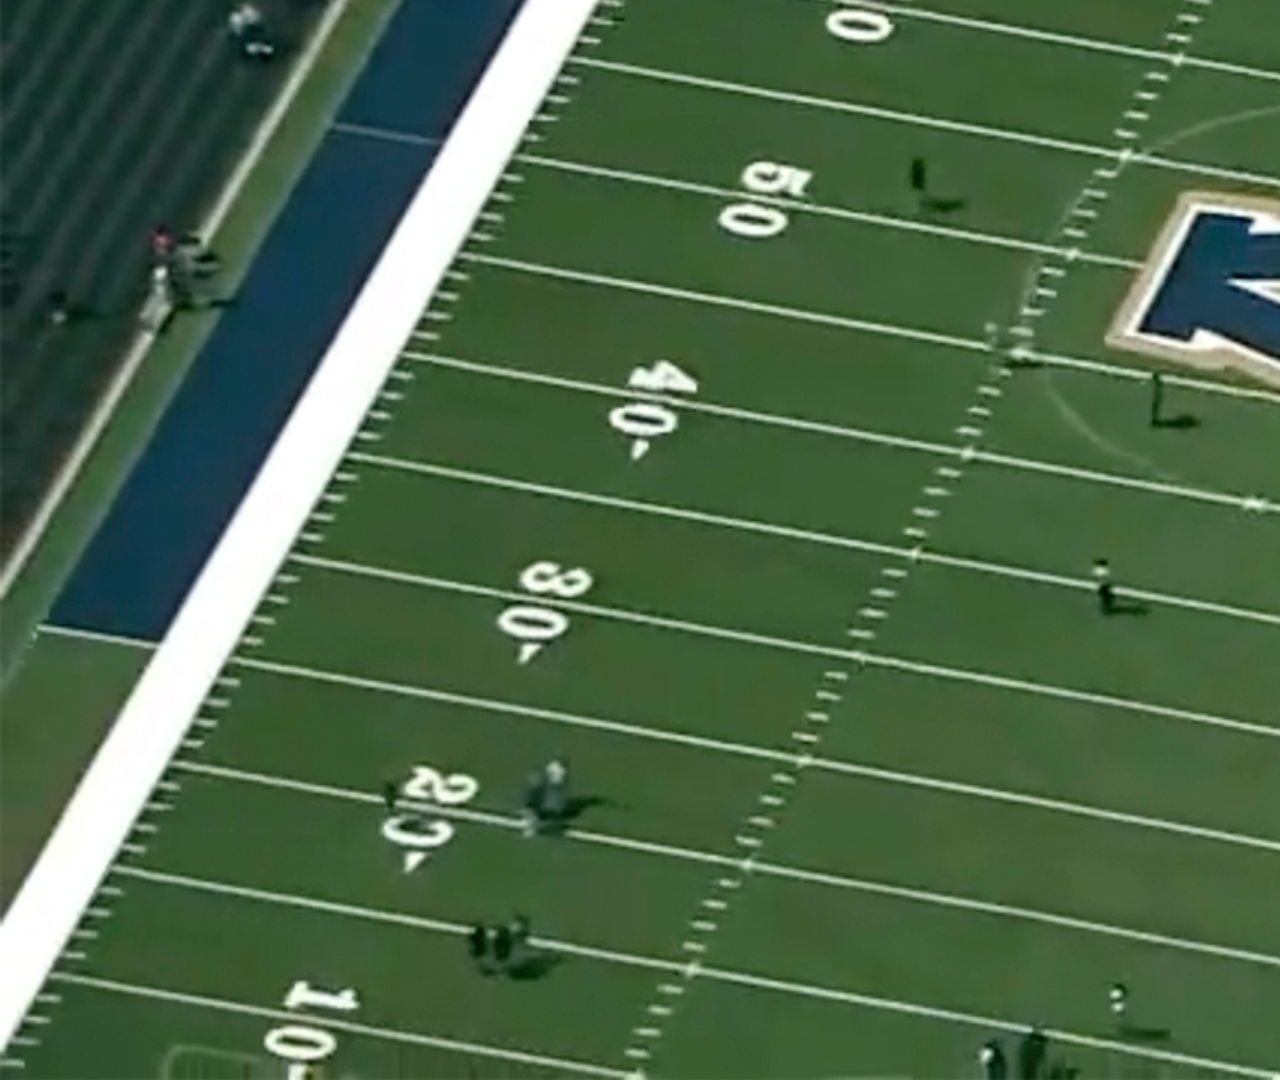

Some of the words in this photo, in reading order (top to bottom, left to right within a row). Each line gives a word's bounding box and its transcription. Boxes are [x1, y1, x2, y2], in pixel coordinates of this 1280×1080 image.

[718, 162, 812, 237] 50
[609, 361, 698, 436] 40
[498, 562, 593, 639] 30
[382, 764, 479, 847] 20
[264, 981, 360, 1060] 10
